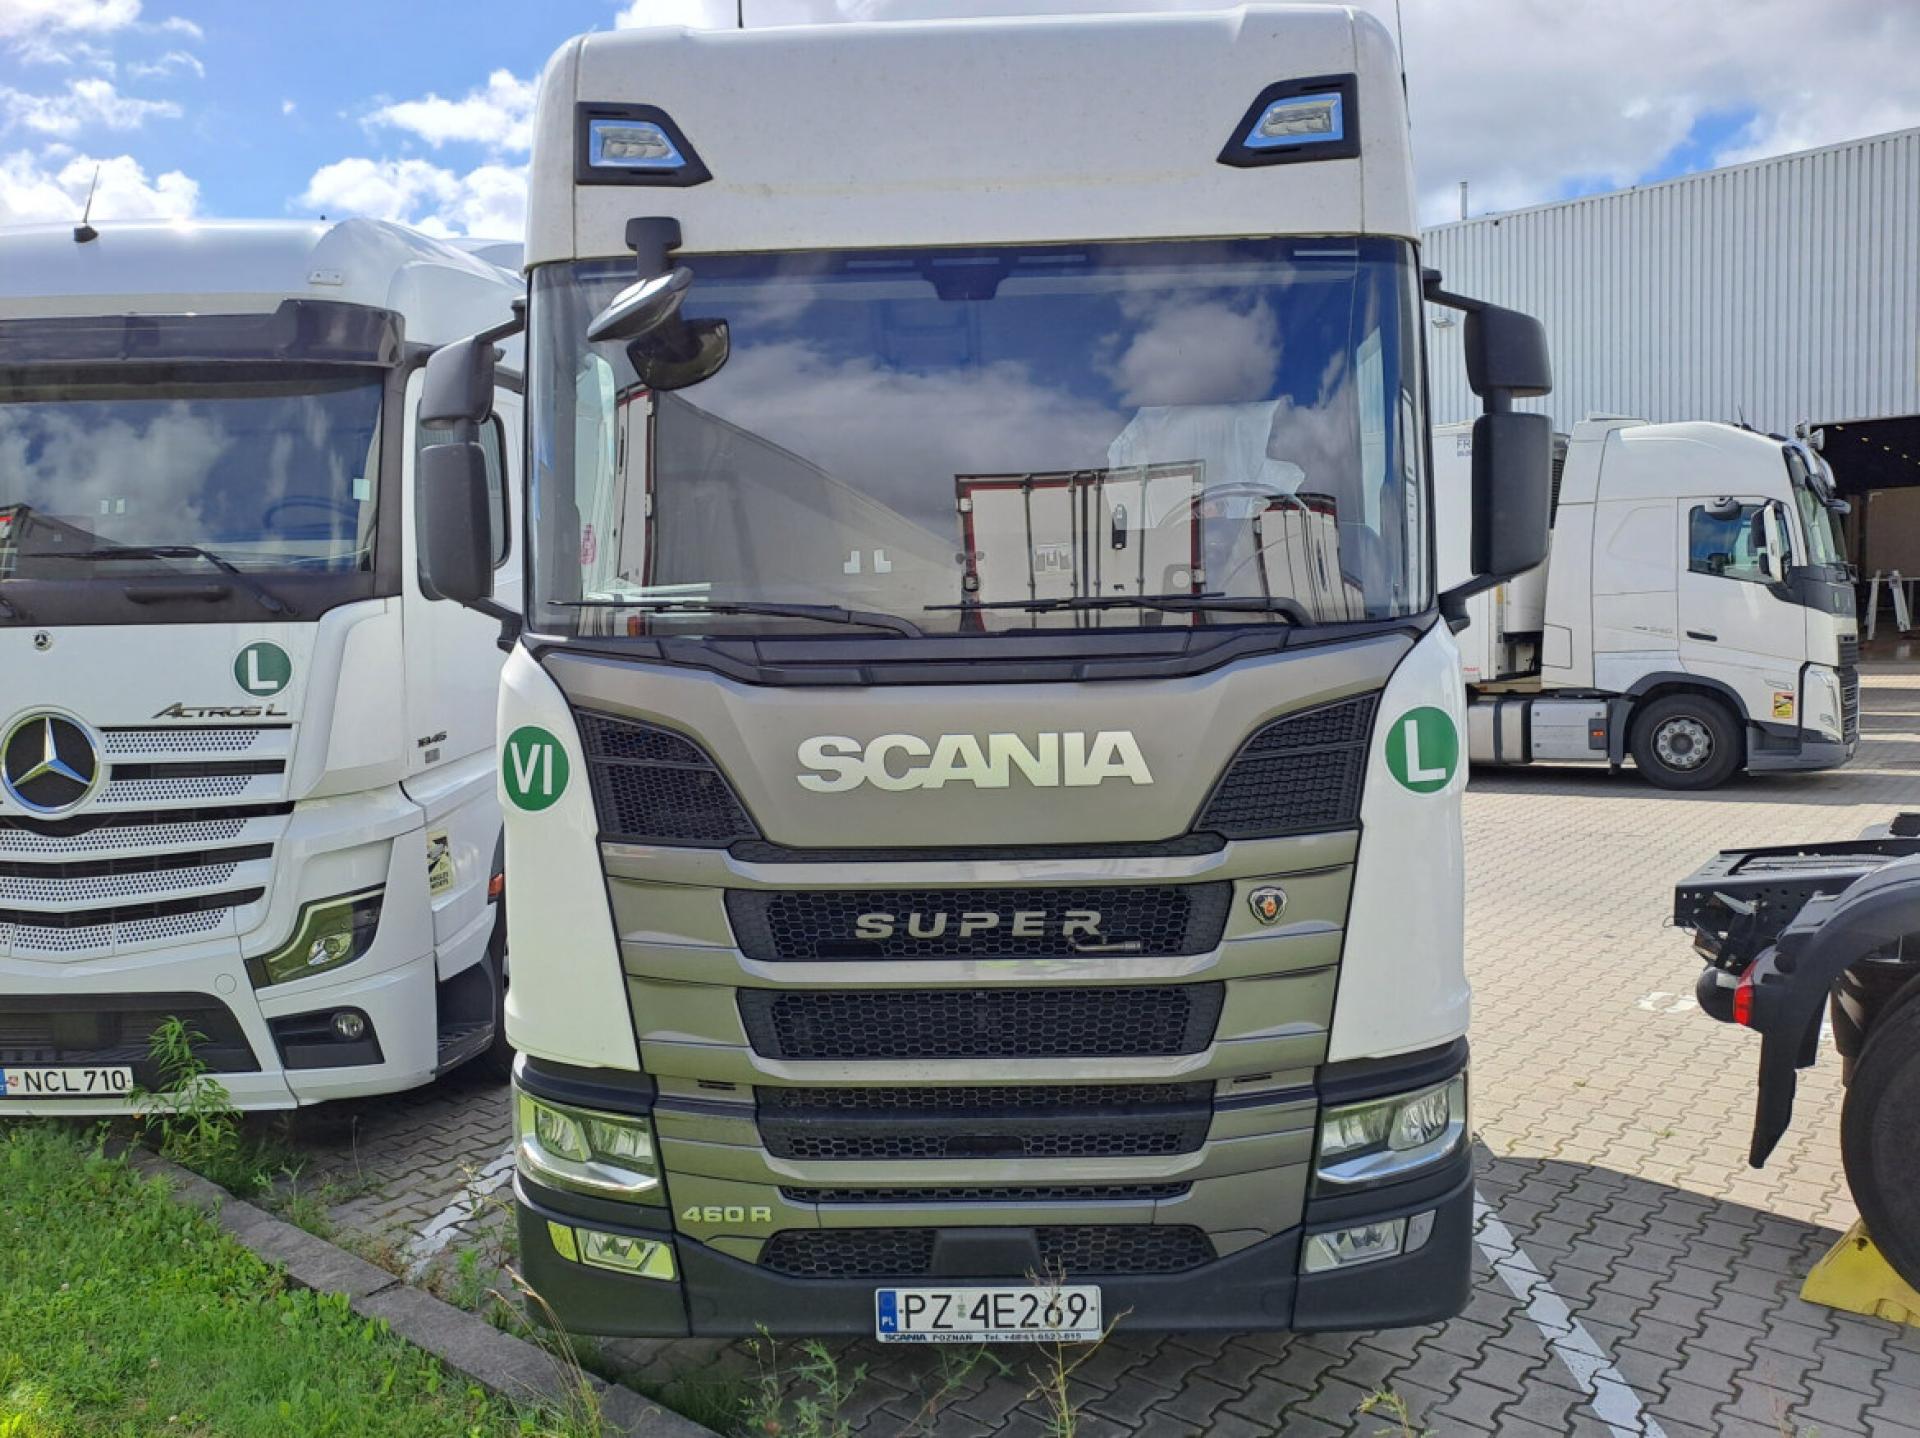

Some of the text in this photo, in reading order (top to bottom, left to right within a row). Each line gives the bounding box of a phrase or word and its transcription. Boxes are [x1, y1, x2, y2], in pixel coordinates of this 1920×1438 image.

[247, 649, 279, 690] L
[265, 703, 288, 717] L
[510, 742, 553, 795] VI
[797, 731, 1154, 792] SCANIA
[1404, 719, 1447, 783] L
[855, 910, 1103, 939] SUPER
[682, 1206, 772, 1222] 460 R
[882, 1317, 895, 1326] PL
[905, 1293, 1087, 1329] PZ 4E269
